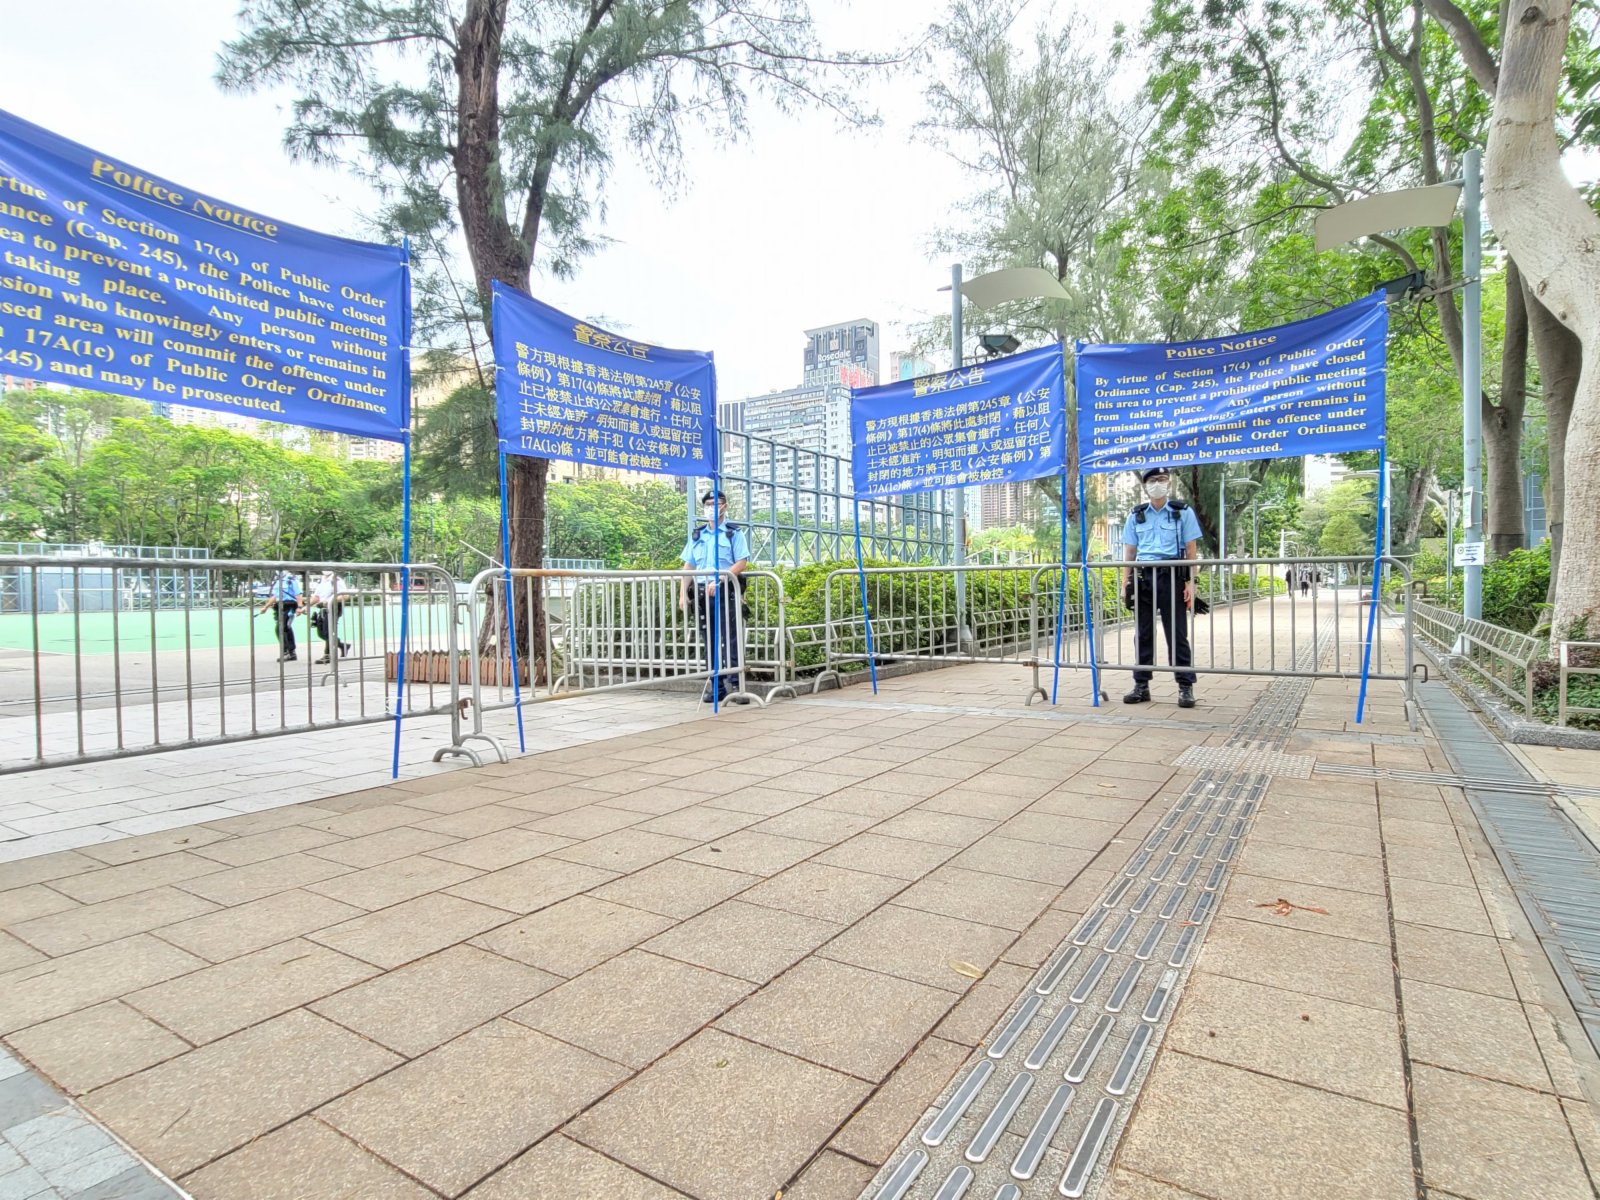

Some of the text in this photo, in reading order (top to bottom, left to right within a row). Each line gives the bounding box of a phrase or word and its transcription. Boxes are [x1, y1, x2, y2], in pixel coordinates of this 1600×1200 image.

[91, 158, 279, 237] Police Notice
[63, 200, 88, 216] of
[101, 208, 179, 245] Section
[194, 239, 239, 266] 17(4)
[251, 262, 270, 274] of
[280, 267, 331, 293] Public
[340, 286, 387, 308] Order
[66, 218, 128, 250] (Cap.
[138, 242, 188, 272] 245),
[199, 262, 229, 281] the
[239, 272, 291, 298] Police
[299, 290, 335, 312] have
[342, 306, 386, 327] closed
[4, 251, 388, 362] taking place. Any person without
[33, 235, 57, 252] to
[64, 244, 152, 279] prevent
[158, 272, 170, 283] a
[175, 277, 269, 313] prohibited
[274, 305, 326, 328] public
[330, 321, 388, 347] meeting
[0, 275, 387, 380] sion who knowingly enters or remains in
[0, 301, 387, 397] sed area will commit the offence under
[572, 323, 649, 359] 警察公告
[1166, 335, 1277, 359] Police Notice
[25, 328, 115, 362] 17A(1c)
[130, 353, 154, 367] of
[166, 357, 229, 383] Public
[241, 374, 296, 395] Order
[307, 387, 387, 415] Ordinance
[817, 350, 851, 362] Rosedale
[1095, 338, 1366, 387] By virtue of Section 17(4) of Public Order
[1095, 387, 1150, 398] Ordinance
[1155, 383, 1186, 394] (Cap.
[1225, 376, 1243, 384] the
[1249, 368, 1284, 380] Police
[1290, 360, 1319, 372] have
[1325, 351, 1366, 365] closed
[0, 347, 286, 414] 45) and may be prosecuted.
[913, 367, 985, 397] 警察公告
[1095, 401, 1114, 410] this
[1116, 399, 1139, 408] area
[1142, 398, 1153, 407] to
[1155, 394, 1197, 407] prevent
[1210, 381, 1269, 400] prohibited
[1272, 374, 1311, 390] public
[1315, 367, 1367, 381] meeting
[1095, 379, 1366, 421] from taking place. Any person without
[1093, 407, 1367, 446] the closed area will commit the offence under
[1094, 393, 1366, 435] permission who knowingly enters or remains in
[1137, 440, 1179, 453] 17A(1c)
[1187, 437, 1198, 446] of
[1206, 433, 1242, 445] Public
[1251, 428, 1289, 440] Order
[1297, 422, 1367, 435] Ordinance
[1092, 443, 1283, 469] (Cap. 245) and may be prosecuted.
